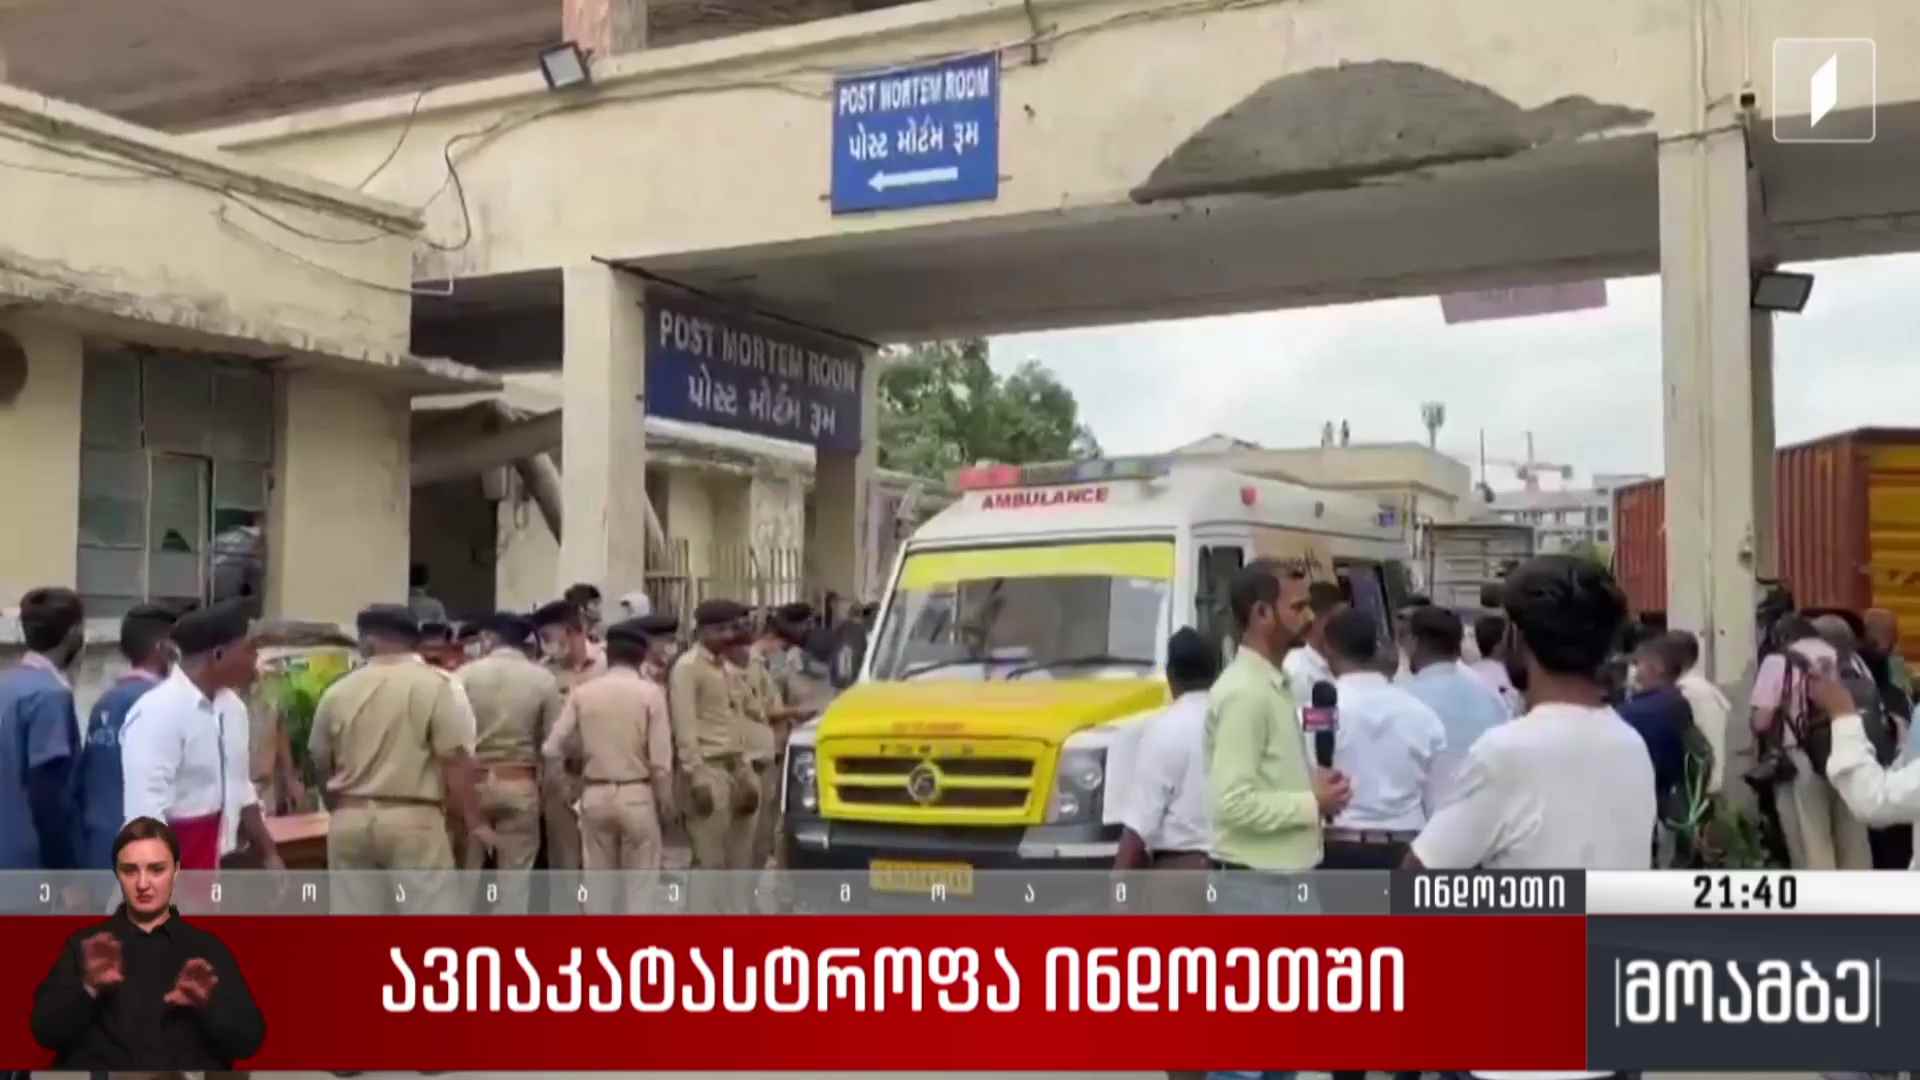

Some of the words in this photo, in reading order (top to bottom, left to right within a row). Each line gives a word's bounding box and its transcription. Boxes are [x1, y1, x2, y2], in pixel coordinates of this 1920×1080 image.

[839, 82, 876, 116] POST
[880, 74, 942, 111] MORTEM
[945, 66, 989, 101] ROOM
[849, 121, 888, 160] પોસ્ટ
[953, 121, 979, 156] રૂમ
[659, 309, 713, 358] POST
[722, 327, 802, 378] MORTEM
[808, 352, 856, 392] ROOM
[688, 363, 738, 416] પોસ્ટ
[982, 487, 1109, 510] AMBULANCE
